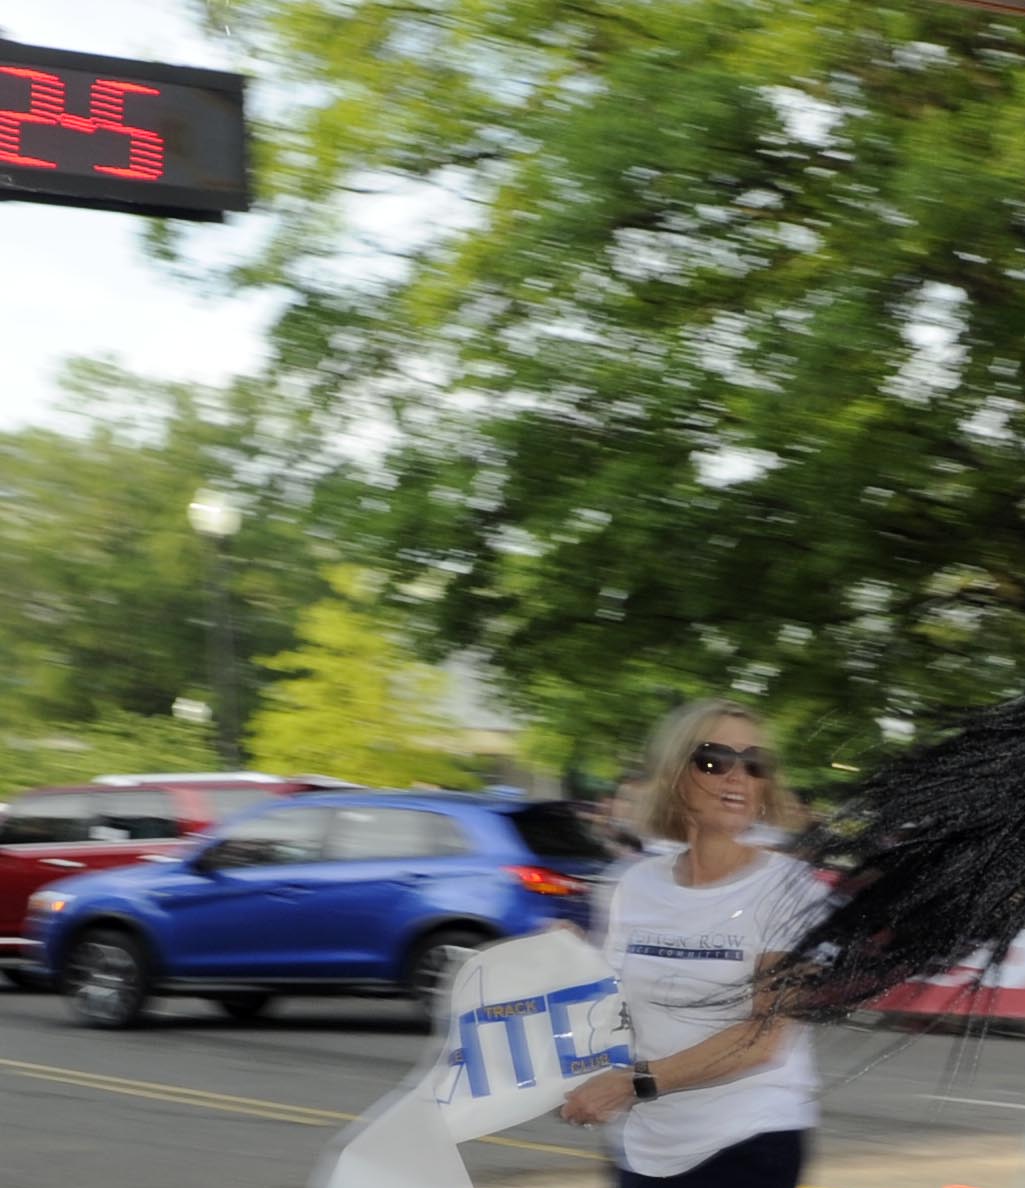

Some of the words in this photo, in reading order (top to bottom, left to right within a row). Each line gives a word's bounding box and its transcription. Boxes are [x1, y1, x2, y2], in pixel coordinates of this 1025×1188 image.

[0, 66, 164, 181] 25
[699, 934, 746, 949] ROW
[486, 1000, 537, 1020] TRACK
